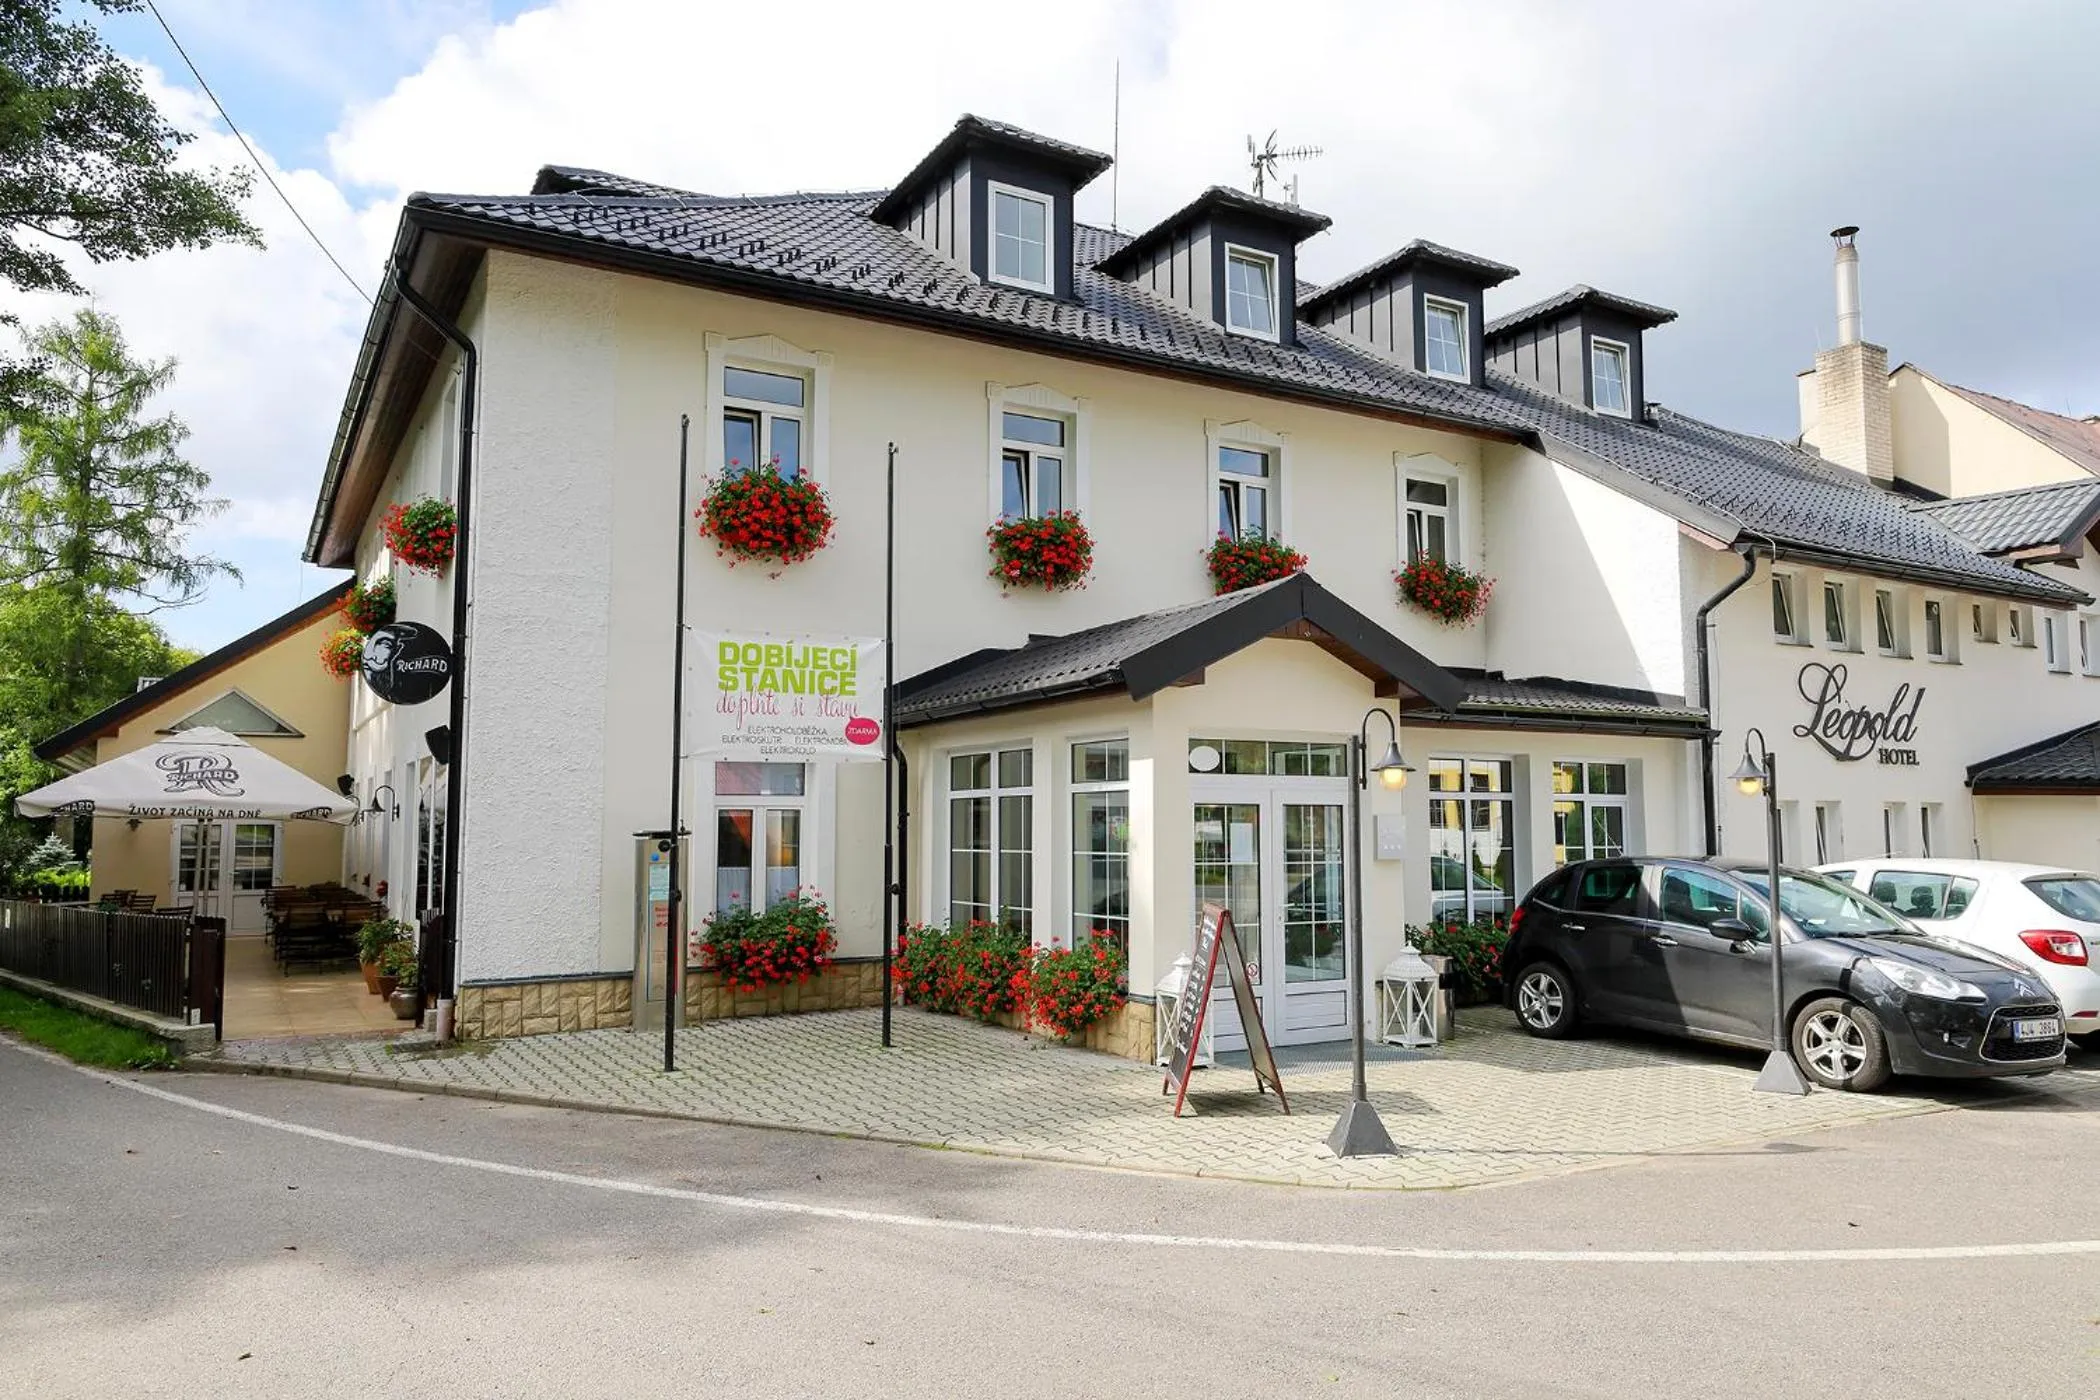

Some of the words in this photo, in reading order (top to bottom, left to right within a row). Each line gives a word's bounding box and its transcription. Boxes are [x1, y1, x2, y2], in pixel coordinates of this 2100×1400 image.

[719, 640, 858, 672] DOBÍJECÍ
[396, 658, 448, 673] RICHARD
[718, 666, 857, 696] STANICE
[792, 697, 805, 717] si
[848, 727, 878, 736] ZDARMA
[760, 745, 817, 756] ELEKTROKOLO
[1878, 748, 1920, 765] HOTEL
[167, 769, 236, 782] RICHARD
[128, 803, 166, 816] ŽIVOT
[170, 805, 214, 817] ZAČÍNÁ
[218, 809, 233, 818] NA
